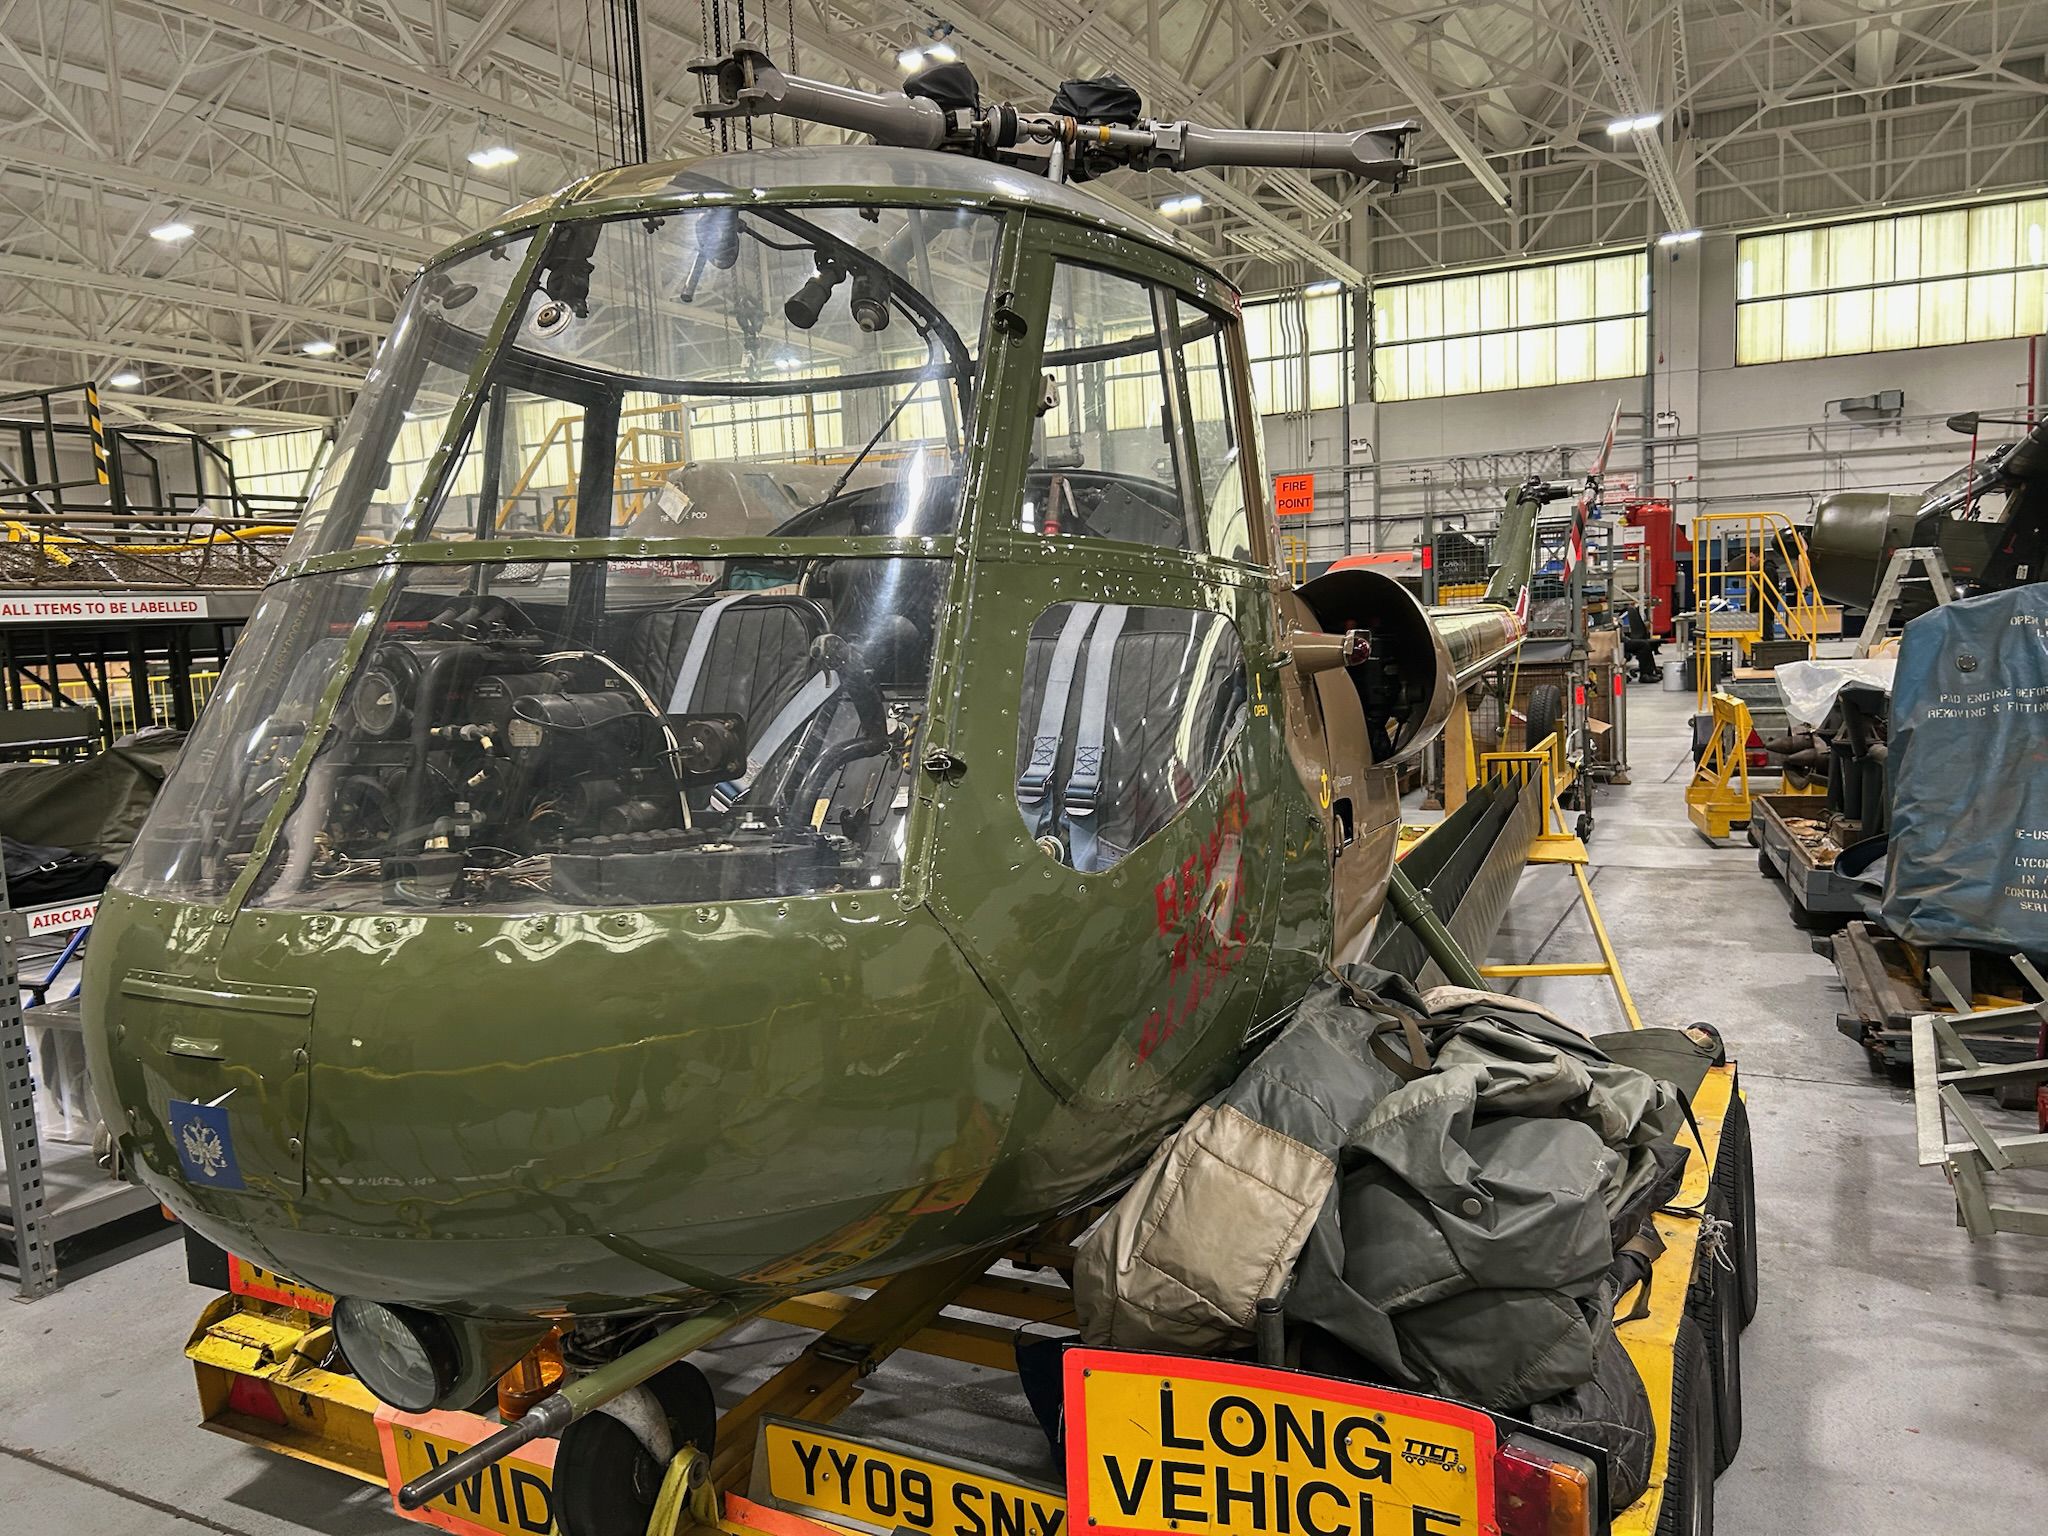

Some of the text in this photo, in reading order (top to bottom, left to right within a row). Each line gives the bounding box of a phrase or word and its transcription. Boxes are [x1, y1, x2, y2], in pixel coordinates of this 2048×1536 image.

[1282, 481, 1307, 492] FIRE
[1278, 497, 1311, 509] POINT
[2, 601, 198, 616] ALL ITEMS TO BE LABELLED
[1967, 686, 2011, 704] ENGINE
[1927, 707, 1986, 719] REMOVING
[2022, 874, 2035, 884] IN
[1159, 1388, 1392, 1486] LONG
[791, 1439, 1066, 1536] YY09 SNY
